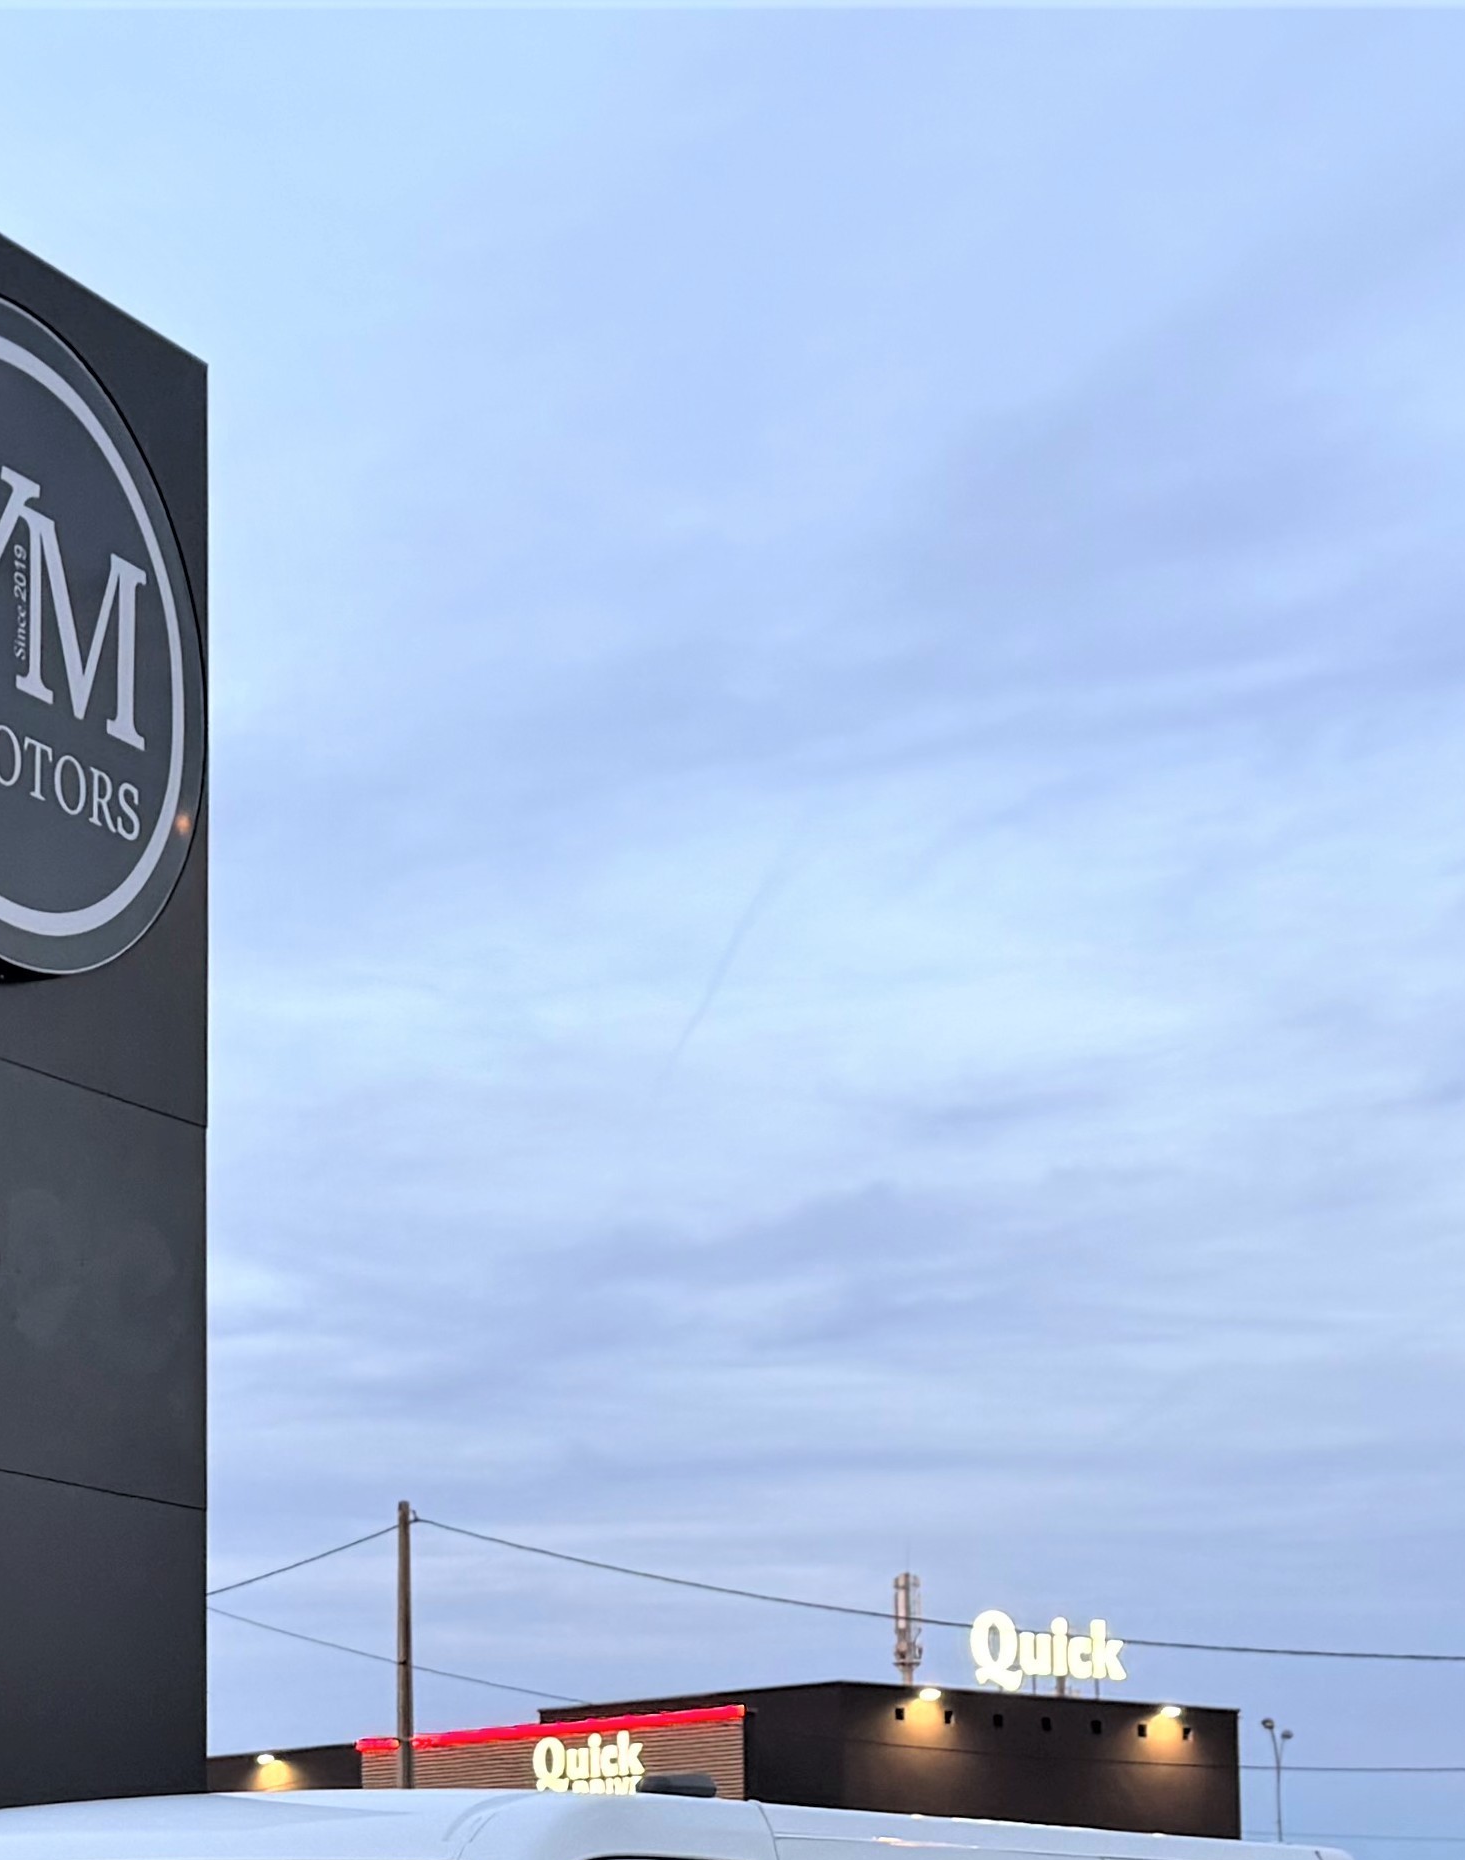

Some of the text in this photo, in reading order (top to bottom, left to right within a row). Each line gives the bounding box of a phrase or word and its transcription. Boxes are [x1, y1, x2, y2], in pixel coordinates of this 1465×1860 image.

[13, 543, 27, 661] Since 2019
[970, 1609, 1127, 1692] Quick
[532, 1729, 646, 1793] Quick
